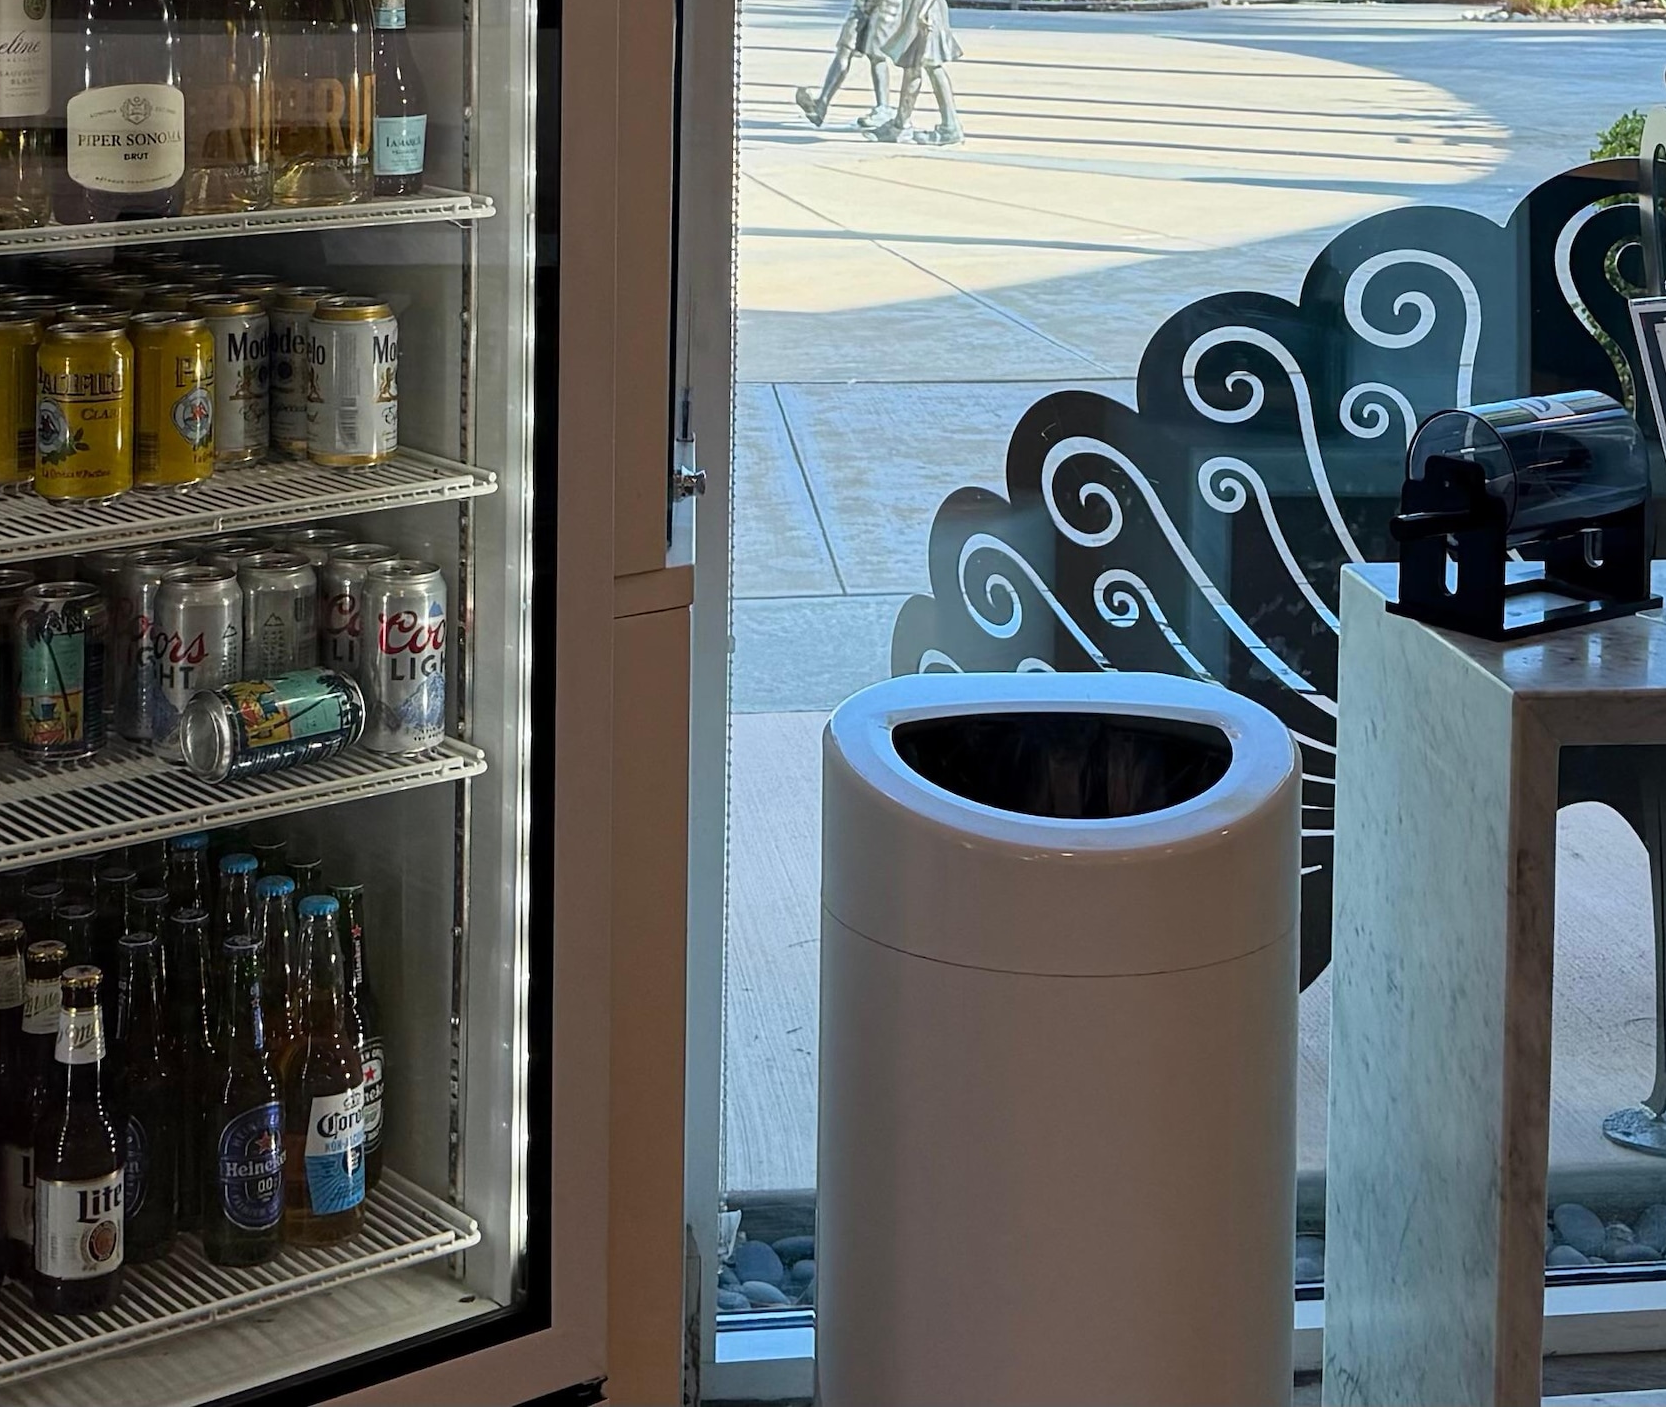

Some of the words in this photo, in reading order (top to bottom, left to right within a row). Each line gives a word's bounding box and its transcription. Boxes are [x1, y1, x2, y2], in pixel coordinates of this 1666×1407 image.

[78, 134, 122, 147] PIPER
[124, 153, 149, 161] BRUT
[228, 332, 267, 362] Mod
[378, 611, 446, 654] Coo
[77, 1182, 123, 1223] Lite
